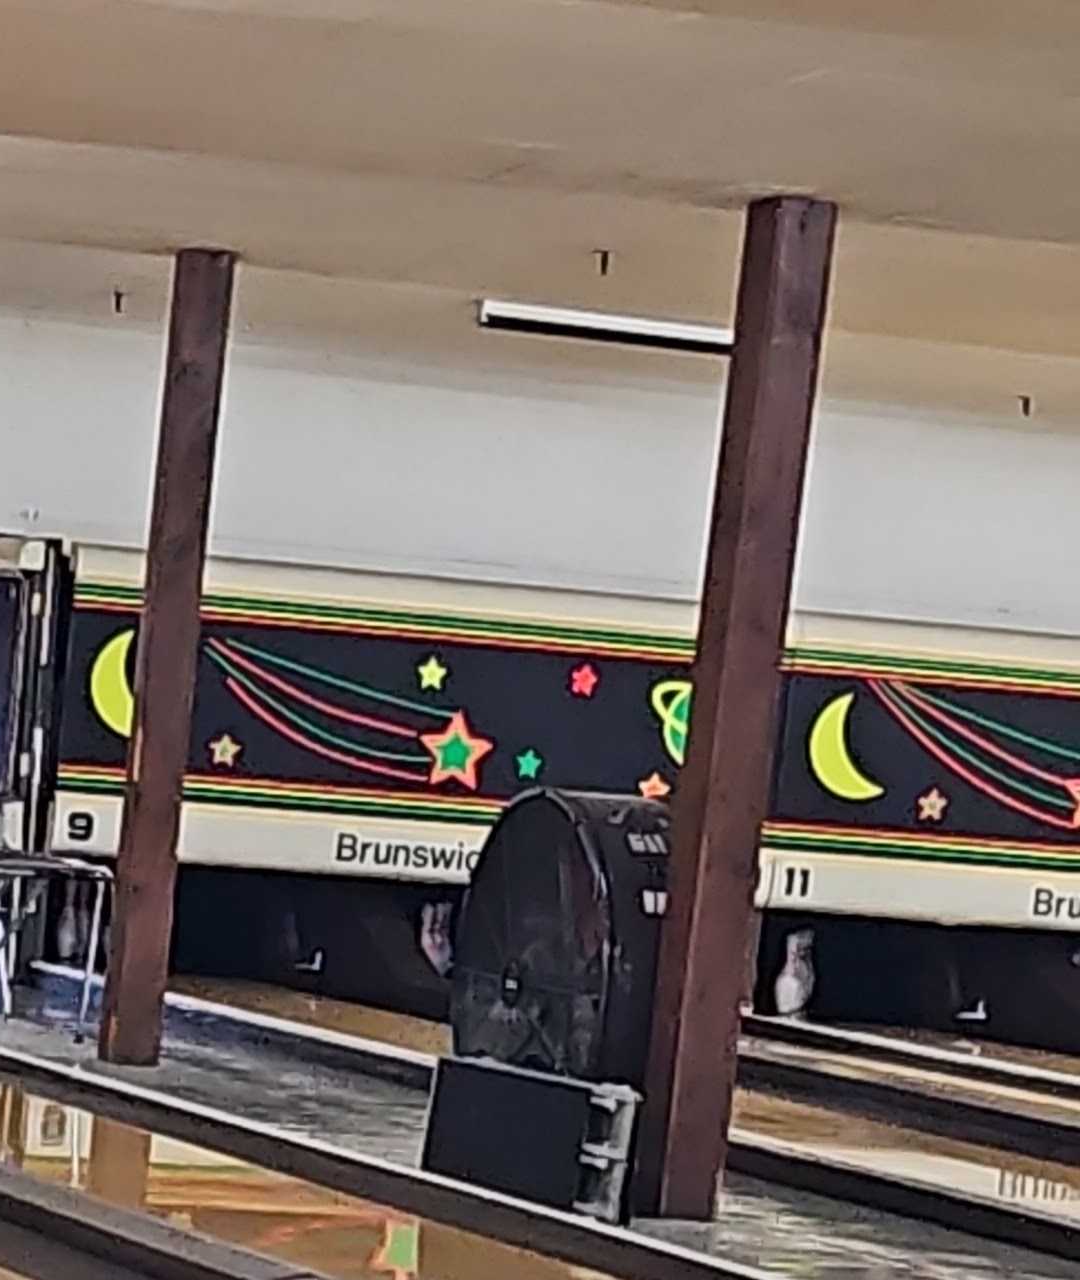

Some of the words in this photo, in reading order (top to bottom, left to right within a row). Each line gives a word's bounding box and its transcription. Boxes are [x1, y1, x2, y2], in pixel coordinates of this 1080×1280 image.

[68, 811, 94, 841] 9
[336, 832, 481, 871] Brunswic
[785, 867, 810, 897] 11
[1033, 887, 1080, 919] Bru
